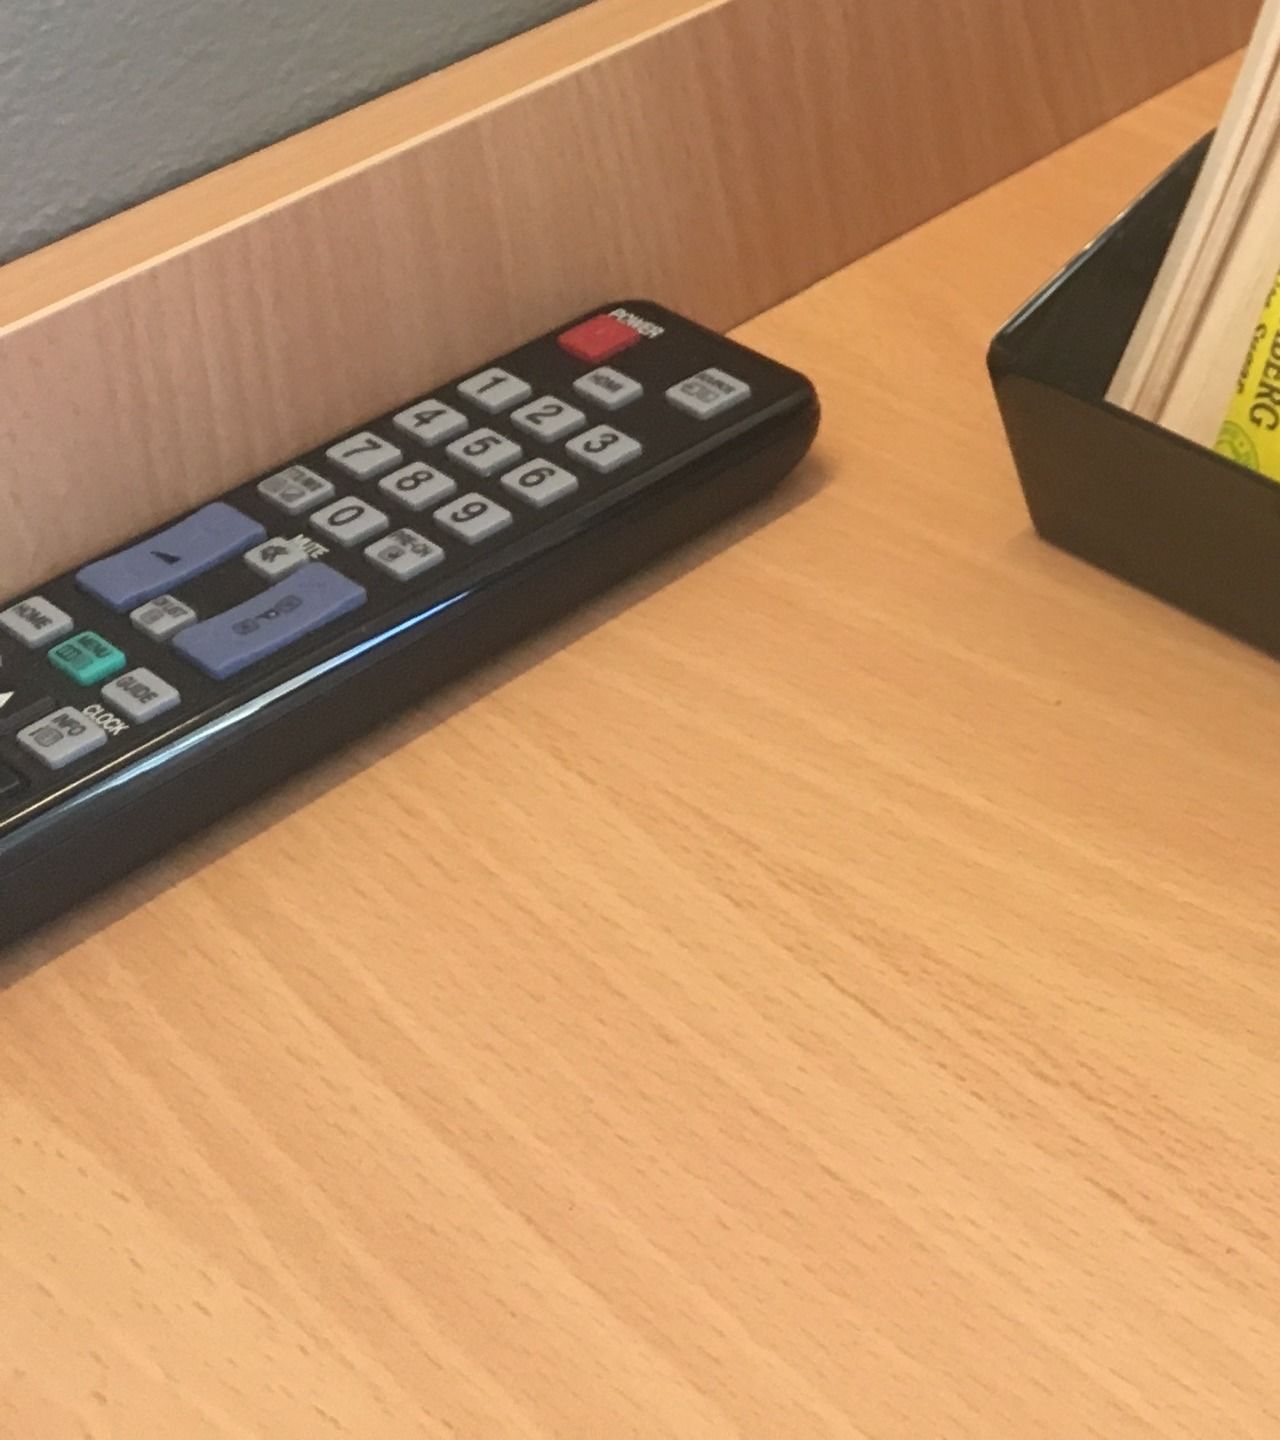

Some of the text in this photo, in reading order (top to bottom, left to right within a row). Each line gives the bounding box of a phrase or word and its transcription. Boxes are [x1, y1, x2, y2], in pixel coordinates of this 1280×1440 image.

[476, 375, 619, 454] 1 2 3
[412, 408, 556, 488] 4 5 6
[341, 437, 489, 523] 7 8 9
[327, 505, 366, 527] 0
[290, 533, 331, 559] MUTE
[115, 674, 158, 705] GUIDE
[51, 712, 87, 738] INFO
[84, 704, 130, 737] CLOCK
